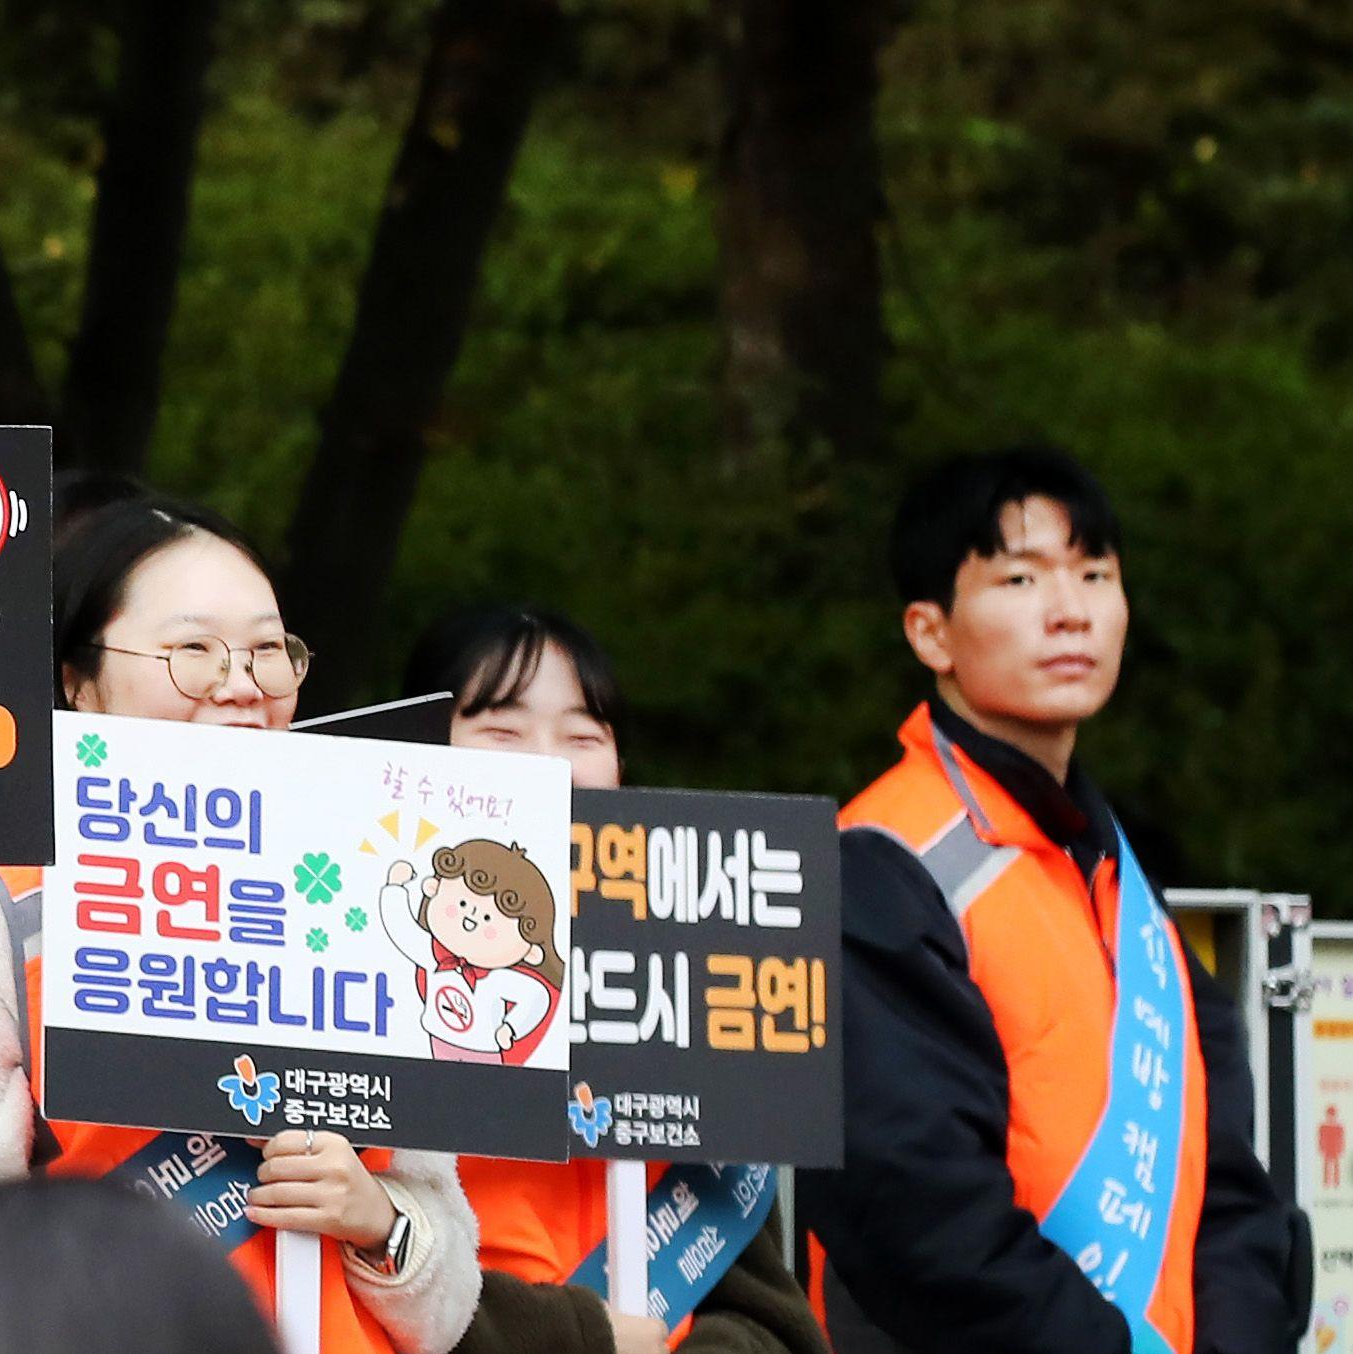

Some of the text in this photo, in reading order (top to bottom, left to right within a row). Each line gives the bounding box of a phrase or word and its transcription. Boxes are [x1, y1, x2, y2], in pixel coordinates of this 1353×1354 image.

[382, 760, 409, 800] 할
[416, 776, 436, 807] 수
[75, 775, 263, 856] 당신의
[73, 853, 287, 949] 금연을
[72, 946, 395, 1038] 응원합니다
[704, 952, 828, 1054] 금연!
[284, 1068, 393, 1101] 대구광역시
[612, 1091, 701, 1121] 대구광역시
[283, 1098, 393, 1131] 중구보건소
[612, 1120, 702, 1147] 중구보건소
